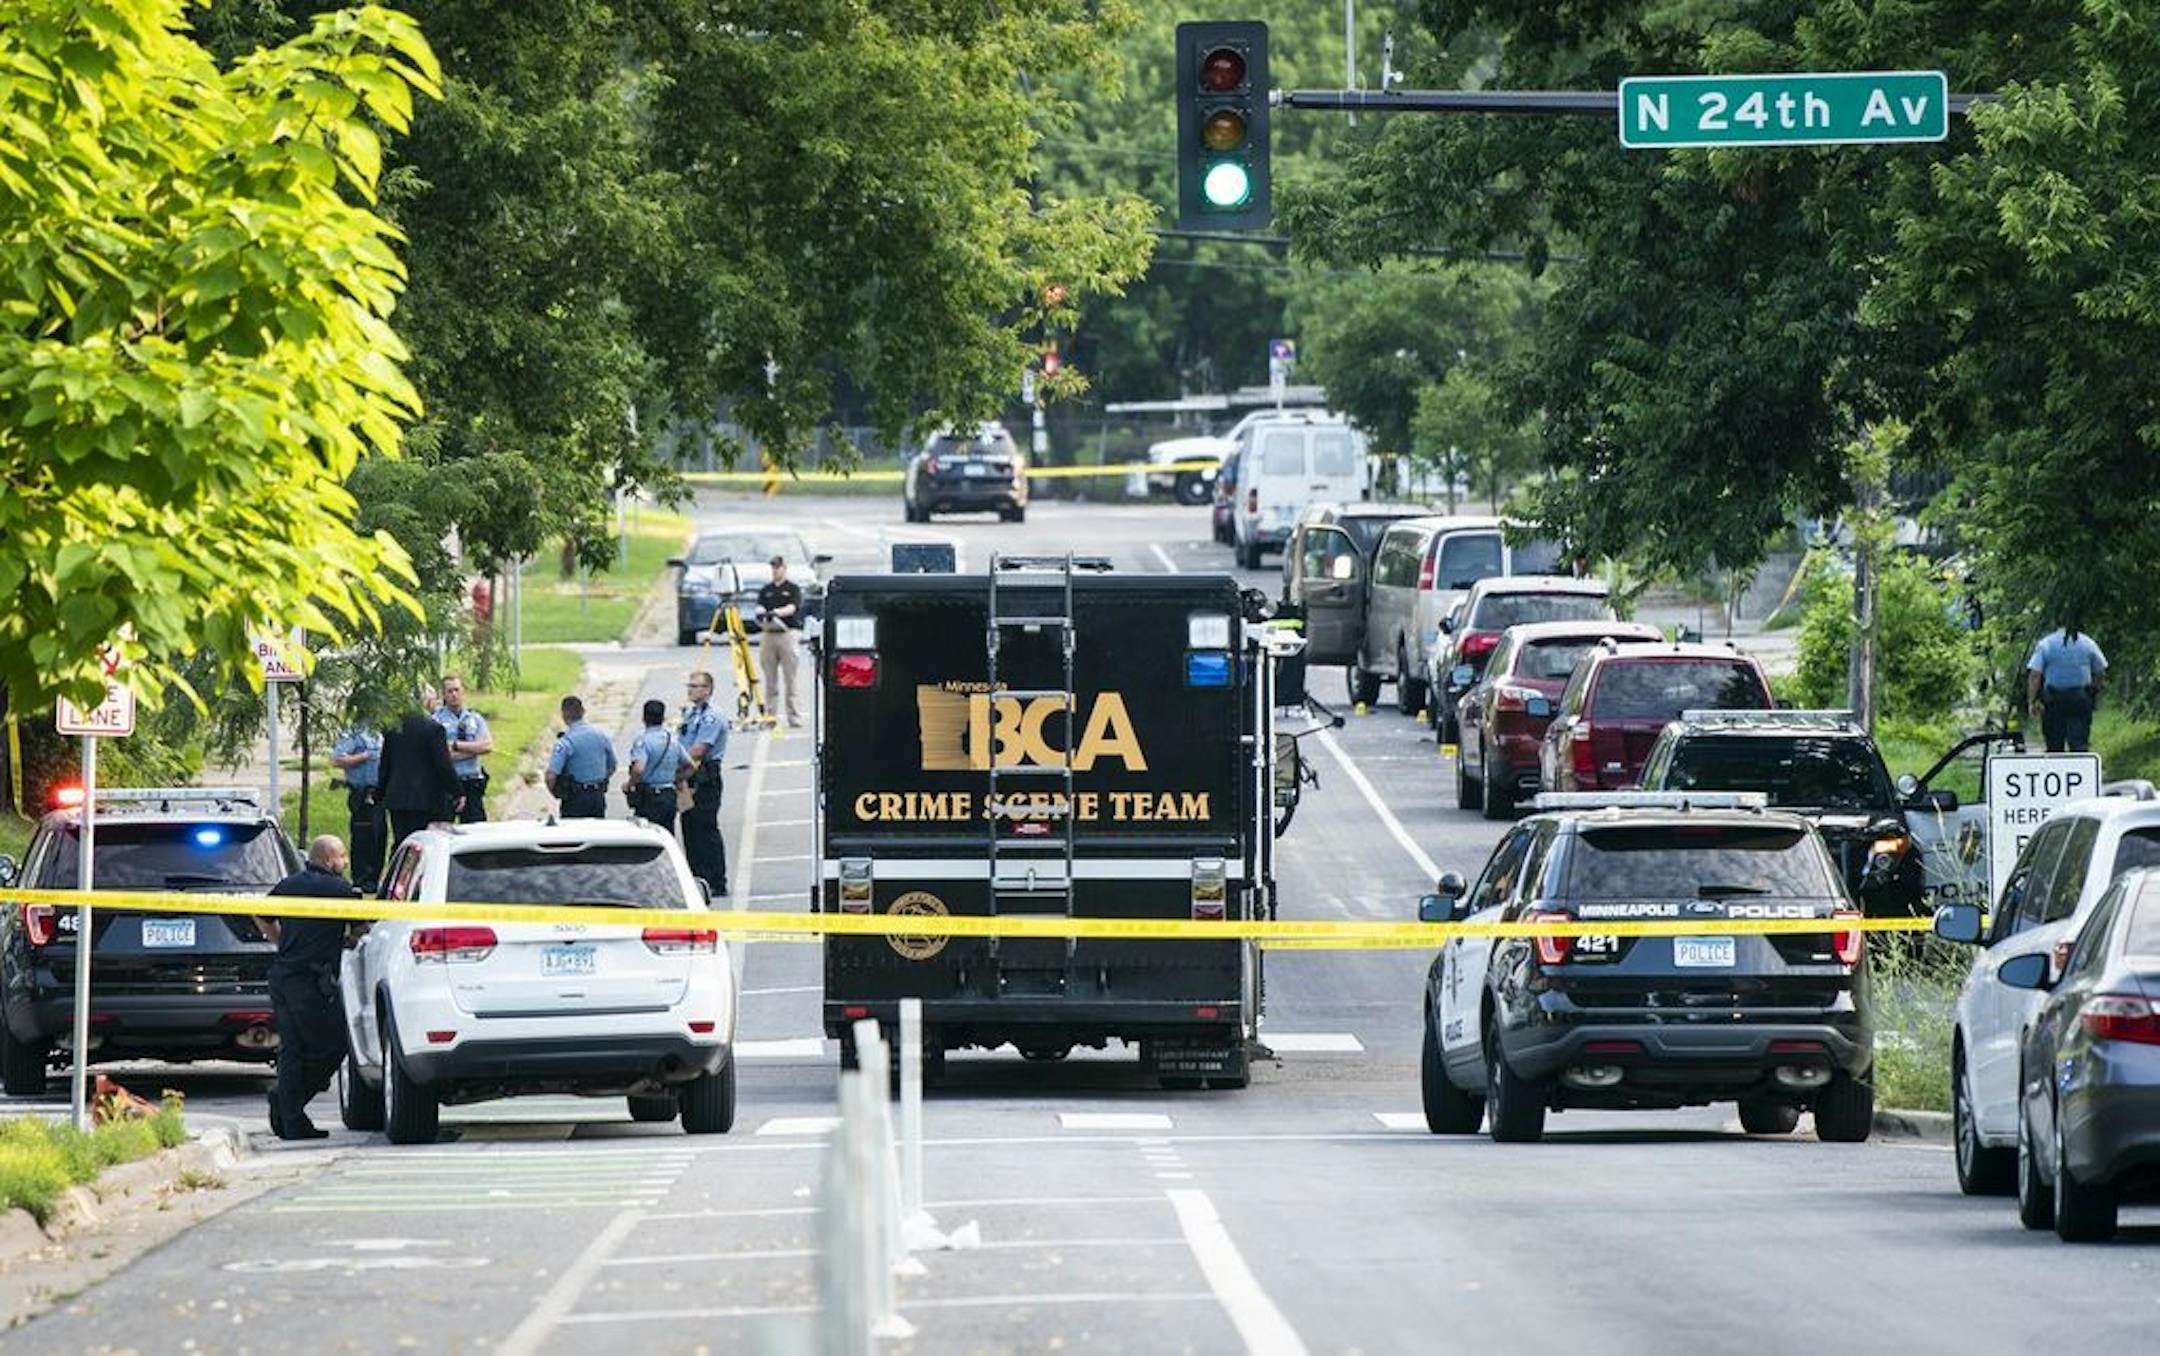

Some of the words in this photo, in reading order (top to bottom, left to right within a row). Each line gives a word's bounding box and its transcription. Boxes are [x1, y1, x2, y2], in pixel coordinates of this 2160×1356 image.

[1637, 93, 1669, 132] N
[1697, 91, 1830, 131] 24th
[1860, 88, 1928, 127] Av
[946, 680, 1008, 693] Minnesta
[969, 692, 1149, 771] BCA
[2004, 771, 2083, 798] STOP
[855, 792, 972, 821] CRIME
[1108, 792, 1211, 821] TEAM
[1578, 903, 1679, 917] MINNEAPOLIS
[1728, 905, 1815, 919] POLICE
[146, 926, 192, 941] POLICE
[1576, 934, 1619, 952] 421
[1680, 944, 1731, 961] POLICE
